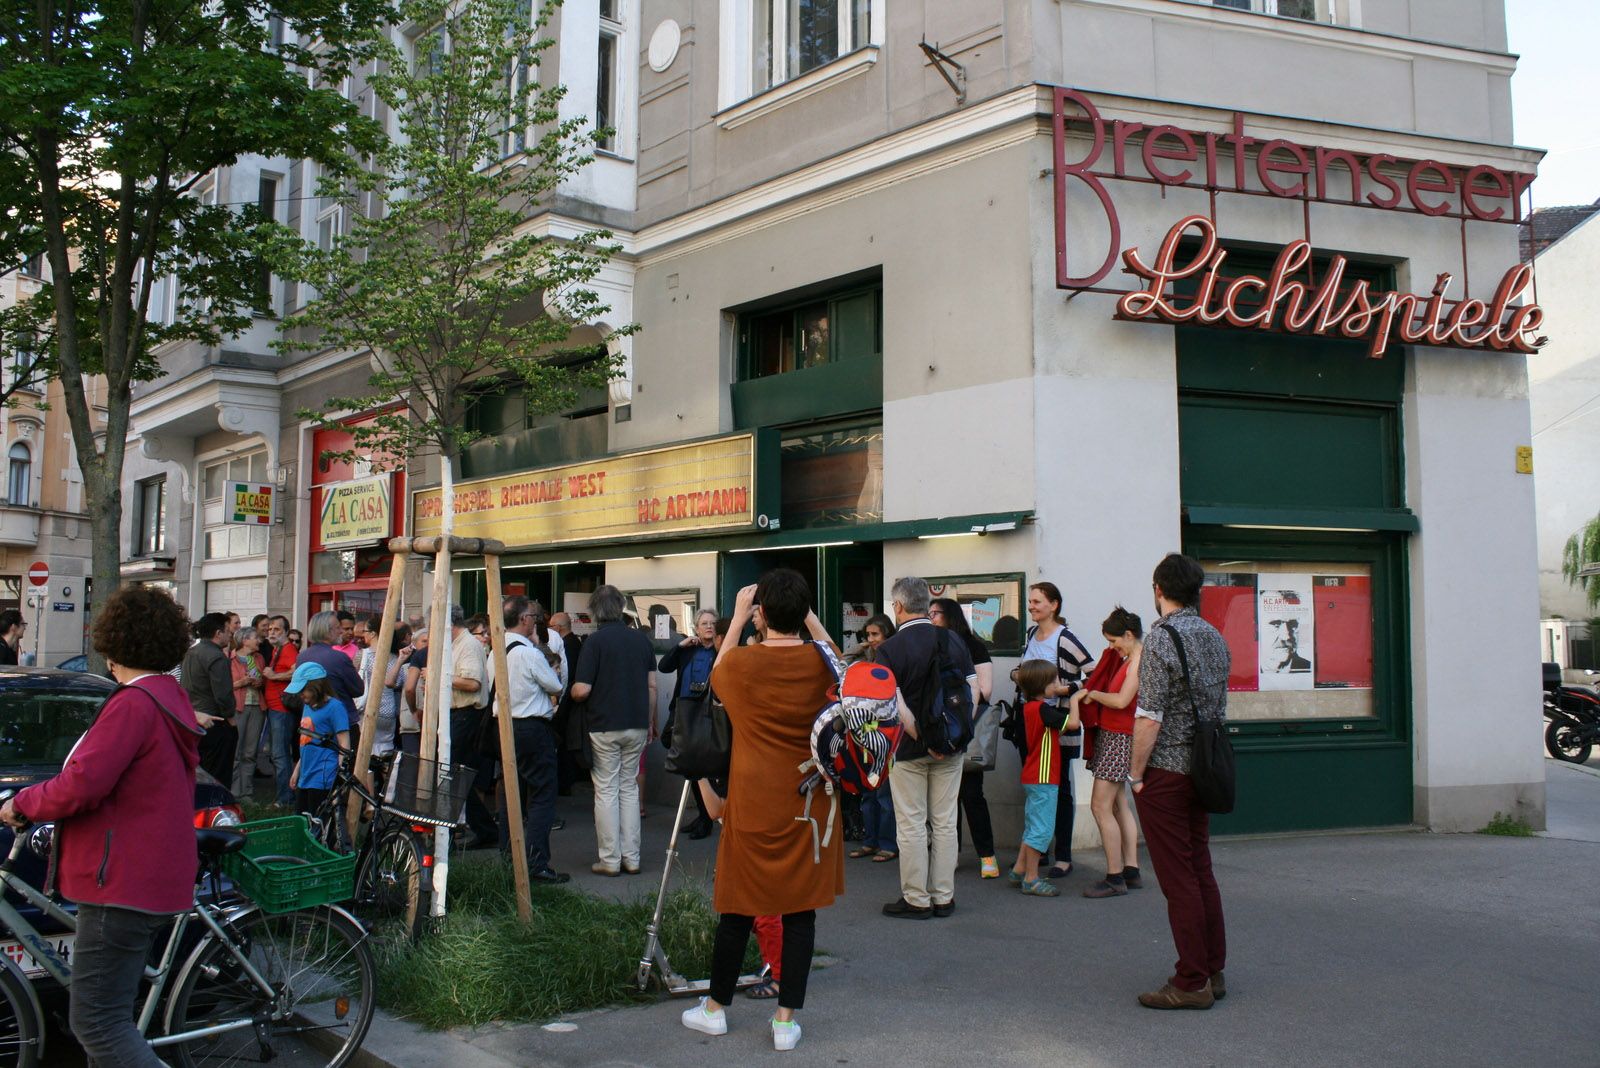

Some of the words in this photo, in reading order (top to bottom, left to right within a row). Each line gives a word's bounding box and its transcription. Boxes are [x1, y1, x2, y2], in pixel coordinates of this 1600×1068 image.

[1053, 87, 1537, 290] Breitenseer
[1114, 214, 1549, 358] Lichtspiele
[236, 492, 247, 507] LA
[248, 494, 270, 509] CASA
[338, 487, 353, 497] PIZZA
[354, 483, 375, 495] SERVICE
[420, 487, 494, 518] SPRHSPIEL
[501, 477, 562, 507] BIENNALE
[568, 471, 606, 499] WEST
[665, 486, 747, 521] ARTMANN
[331, 501, 347, 525] LA
[350, 495, 384, 522] CASA
